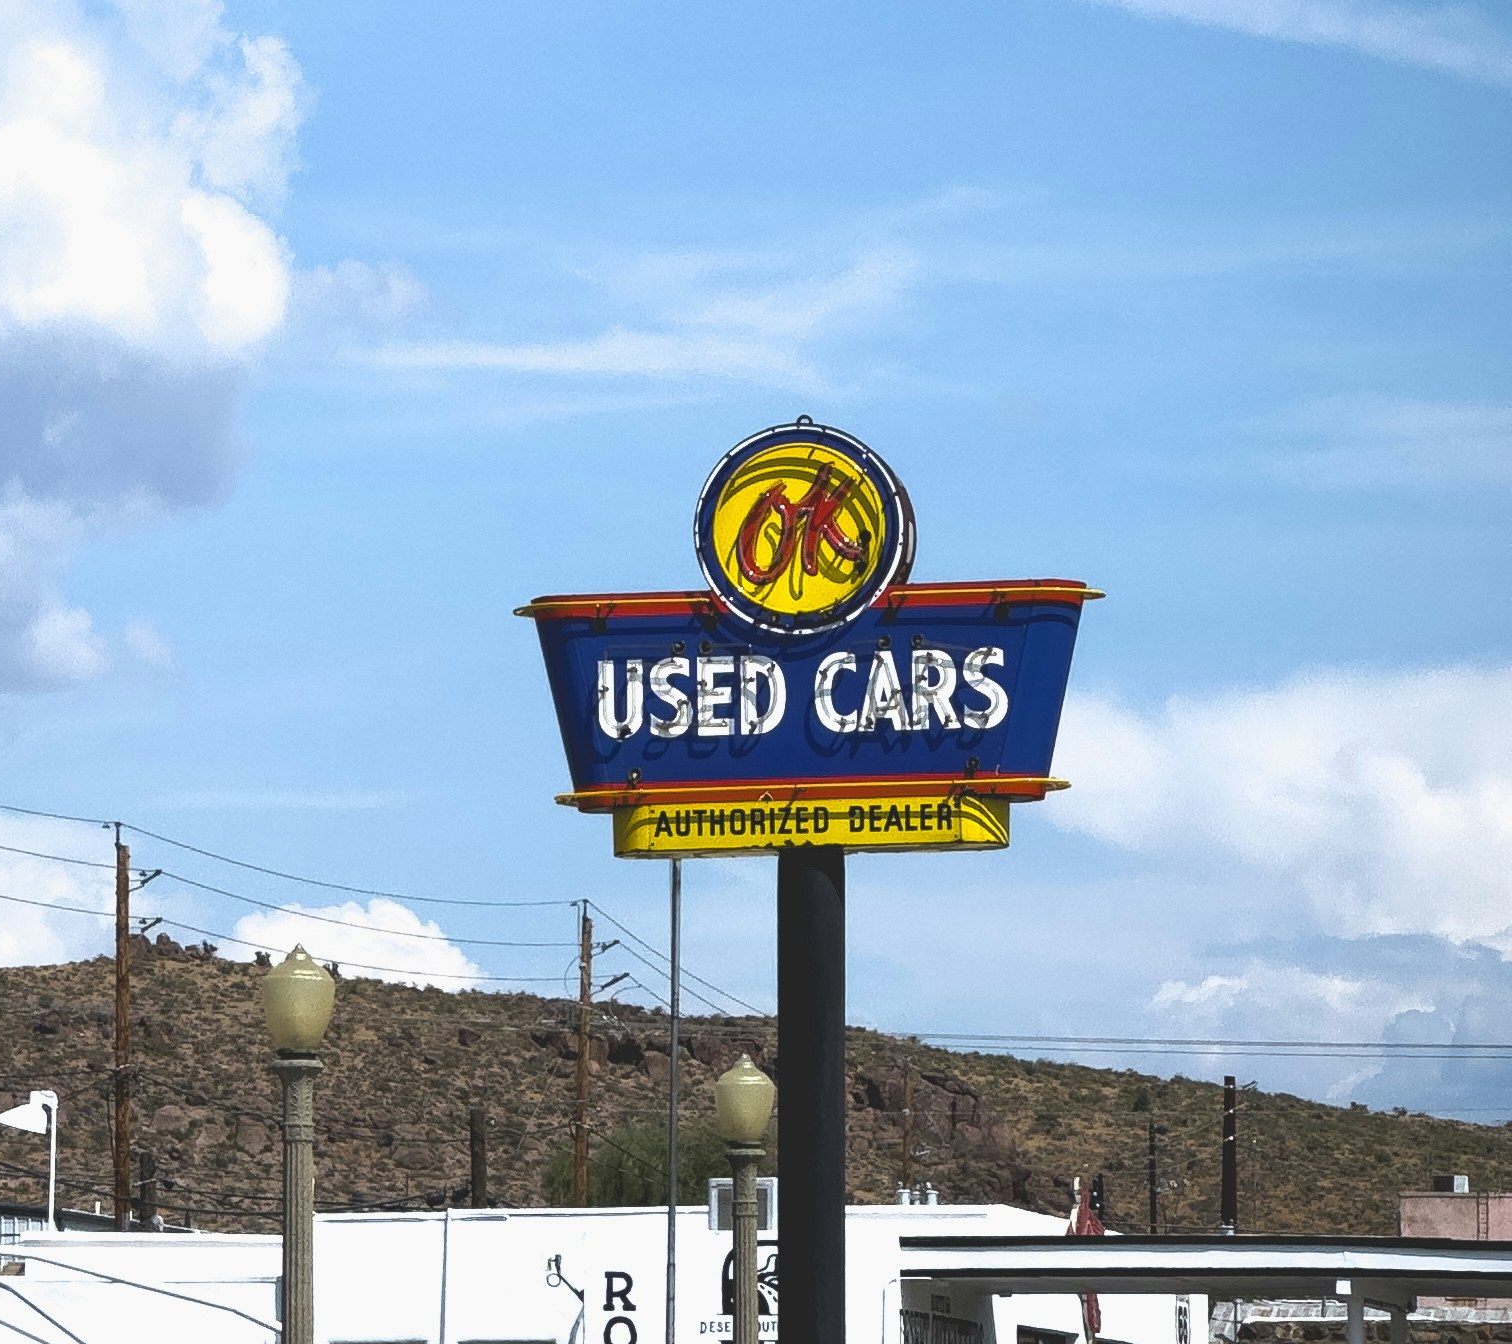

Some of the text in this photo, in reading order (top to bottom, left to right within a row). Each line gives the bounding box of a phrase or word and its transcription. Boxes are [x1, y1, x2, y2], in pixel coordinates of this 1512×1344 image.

[735, 462, 866, 585] OK
[596, 646, 1009, 739] USED CARS
[653, 803, 953, 839] AUTHORIZED DEALER
